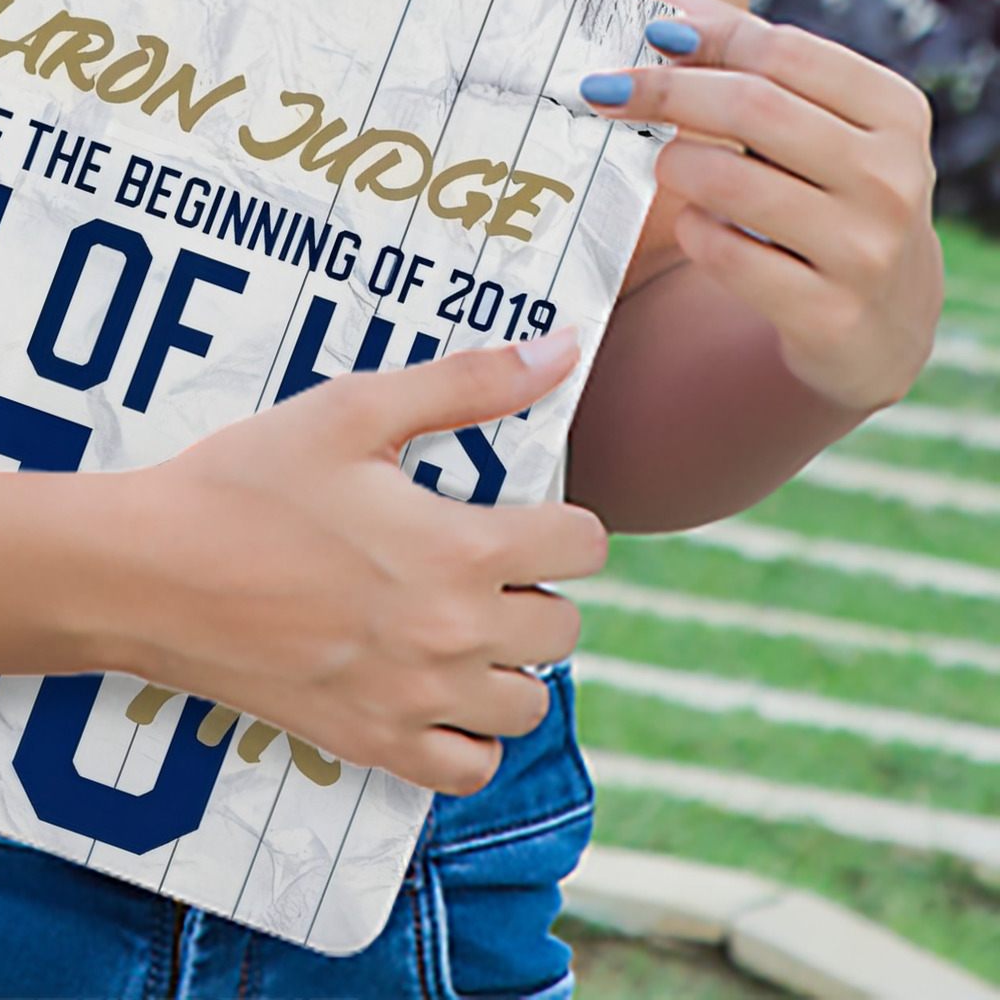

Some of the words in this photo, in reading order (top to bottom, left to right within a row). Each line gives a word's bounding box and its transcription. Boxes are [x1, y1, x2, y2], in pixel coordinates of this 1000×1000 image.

[22, 120, 111, 194] THE
[115, 155, 362, 281] BEGINNING
[367, 244, 436, 304] OF
[436, 268, 558, 342] 2019
[238, 91, 575, 242] JUDGE
[25, 217, 251, 414] OF
